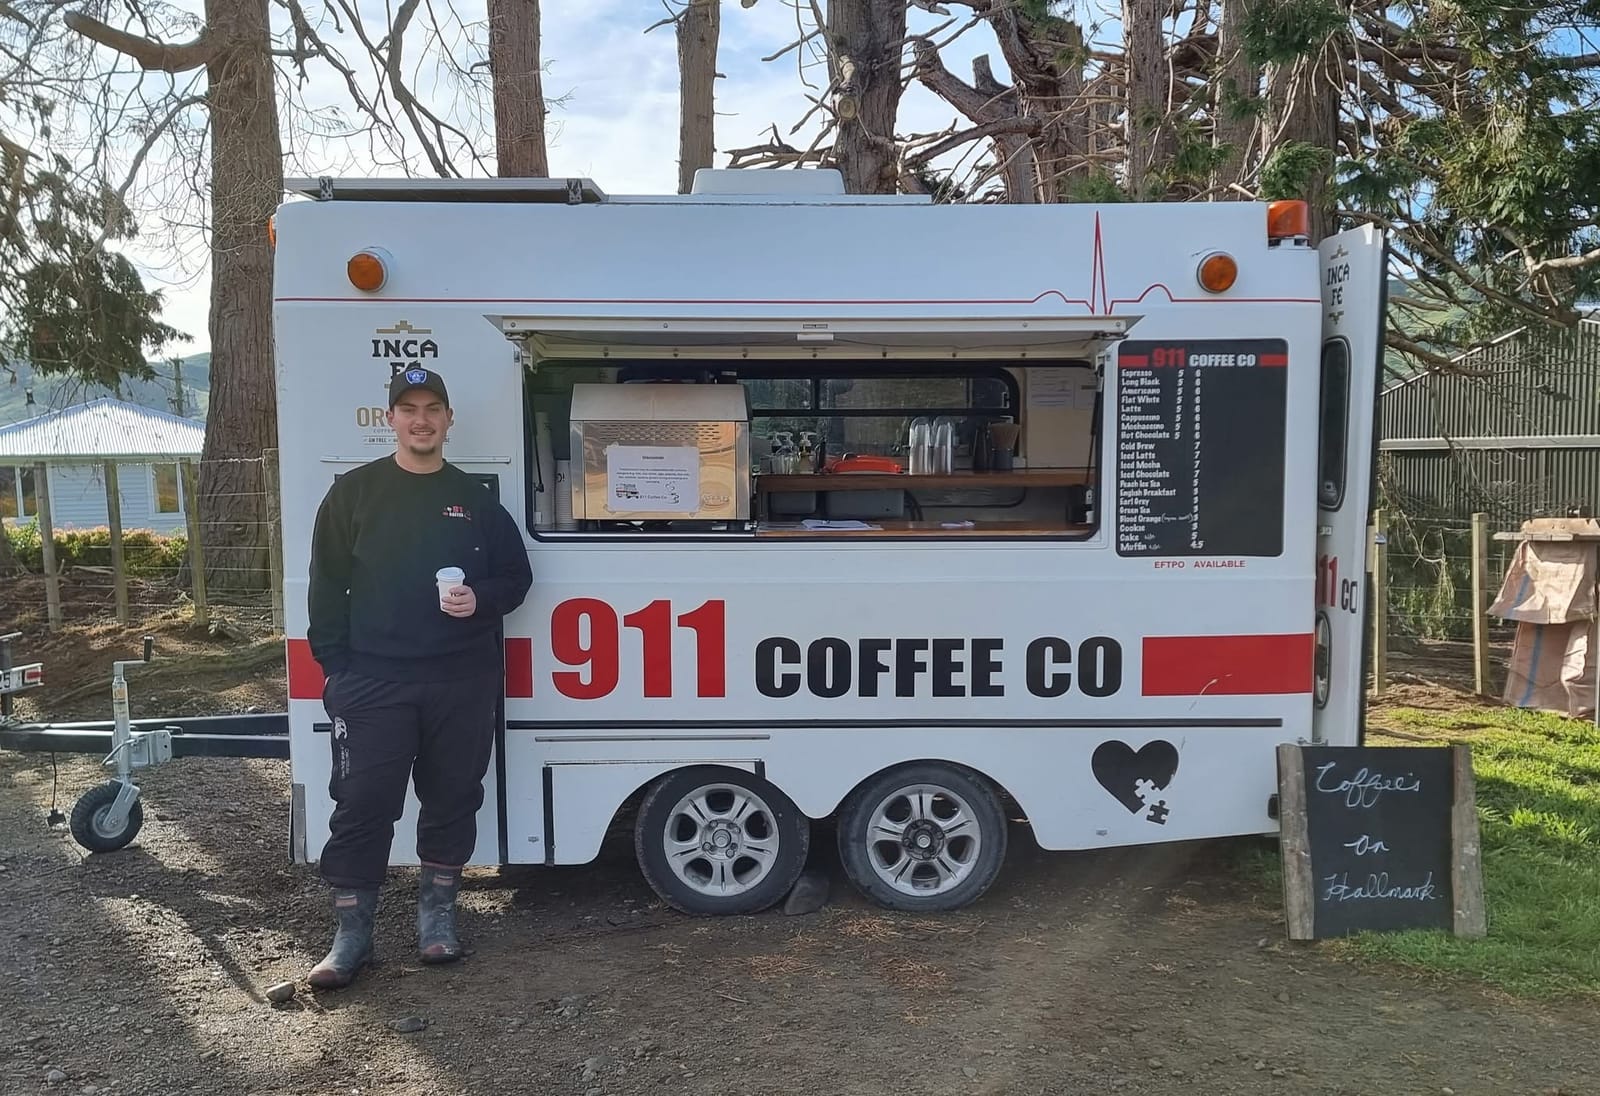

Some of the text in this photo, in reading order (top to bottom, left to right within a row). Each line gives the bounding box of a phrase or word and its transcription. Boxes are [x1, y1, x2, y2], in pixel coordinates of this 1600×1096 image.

[1327, 263, 1350, 286] INCA
[372, 339, 438, 358] INCA
[1153, 348, 1256, 367] 911 COFFEE CO
[1121, 369, 1201, 378] Espresso 5 6
[1121, 377, 1201, 387] Long Black 5 6
[1178, 387, 1184, 395] 5
[1195, 387, 1201, 395] 6
[1177, 396, 1183, 404] 5
[1194, 396, 1200, 404] 6
[1176, 405, 1182, 413] 5
[1194, 405, 1200, 413] 6
[1176, 414, 1182, 422] 5
[1194, 414, 1200, 422] 6
[1176, 423, 1182, 431] 5
[1194, 423, 1200, 431] 6
[1135, 431, 1170, 439] Chocolate
[1175, 432, 1181, 440] 5
[1194, 432, 1200, 440] 6
[1120, 441, 1200, 450] Cold Brew 7
[1120, 451, 1200, 459] Iced Latte 7
[1120, 460, 1200, 469] Iced Mocha 7
[1120, 469, 1200, 478] Iced Chocolate 7
[1120, 489, 1142, 497] English
[1143, 488, 1176, 496] Breakfast
[1138, 515, 1161, 523] Orange
[1120, 524, 1145, 532] Cookie
[1120, 542, 1147, 551] Muffin
[1154, 560, 1246, 569] EFTPO AVAILABLE
[1316, 554, 1338, 608] 11
[550, 597, 1123, 700] 911 COFFEE CO
